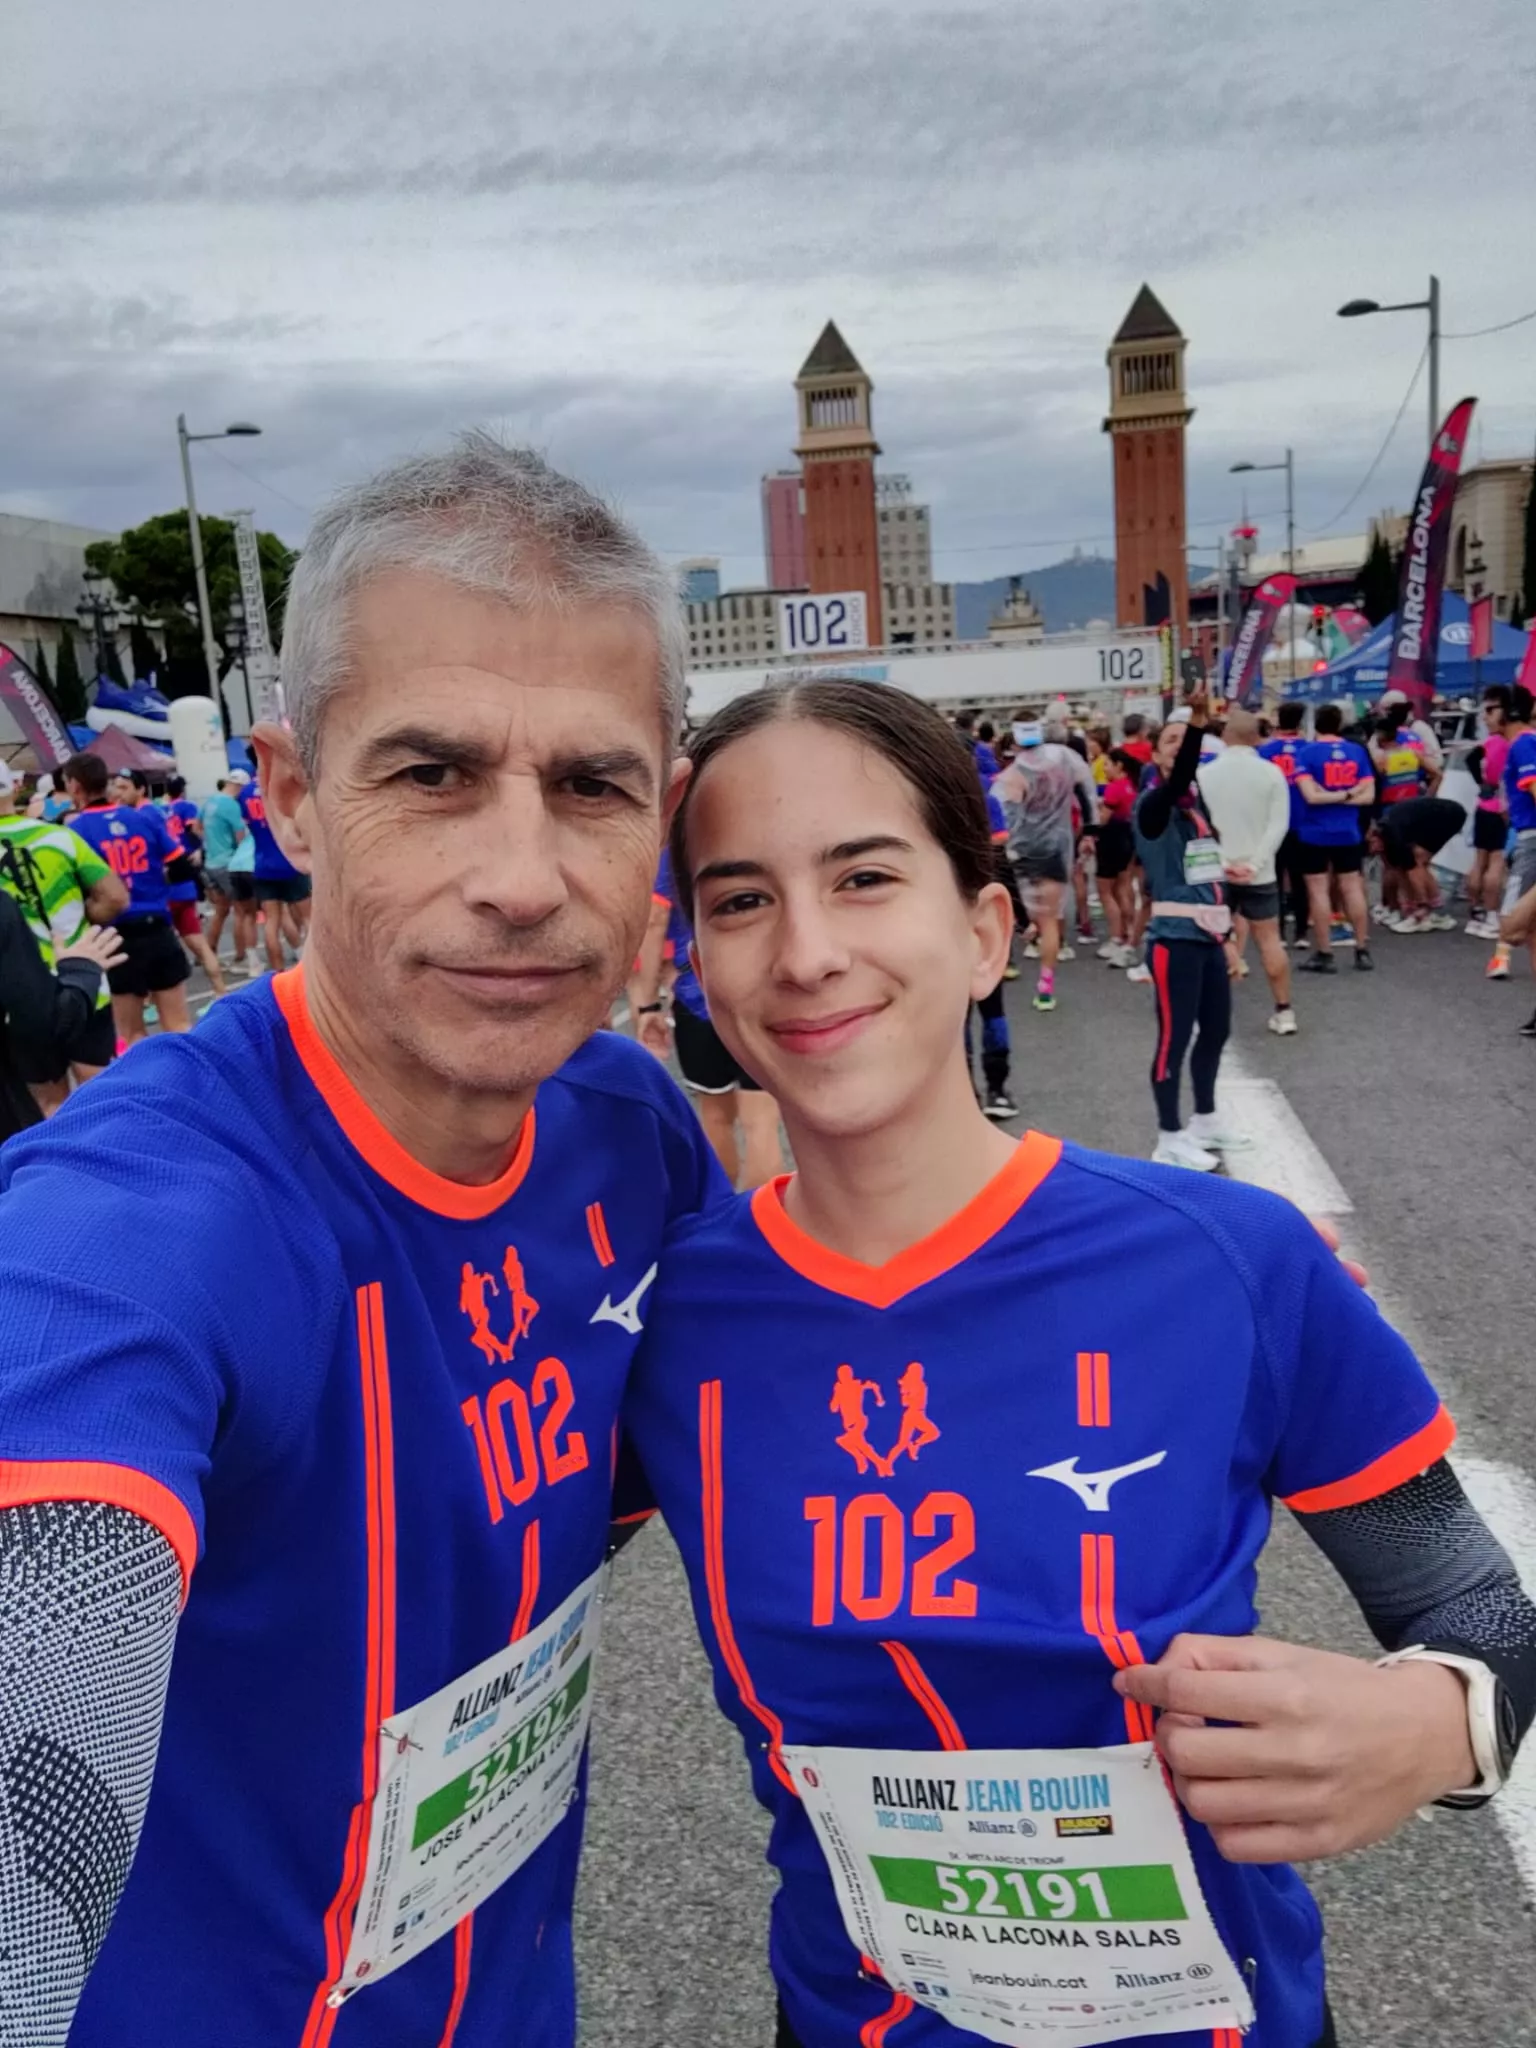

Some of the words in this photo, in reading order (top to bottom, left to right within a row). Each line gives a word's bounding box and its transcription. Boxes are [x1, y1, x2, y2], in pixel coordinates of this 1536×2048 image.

[1399, 486, 1437, 660] BARCELONA
[785, 600, 847, 648] 102
[1097, 647, 1143, 682] 102
[1225, 608, 1263, 699] BARCELONA
[1323, 760, 1358, 787] 102
[100, 835, 149, 875] 102
[461, 1356, 589, 1525] 102
[804, 1491, 978, 1626] 102
[449, 1661, 524, 1733] ALLIANZ
[464, 1689, 569, 1811] 52192
[420, 1822, 465, 1866] JOSE
[470, 1806, 485, 1830] M
[488, 1751, 546, 1813] LACOMA
[871, 1775, 960, 1811] ALLIANZ
[965, 1778, 1023, 1812] JEAN
[1028, 1773, 1111, 1812] BOUIN
[876, 1810, 900, 1829] 102
[967, 1820, 1017, 1835] Allianz
[1059, 1816, 1109, 1829] MUNDO
[936, 1866, 1112, 1919] 52191
[905, 1913, 976, 1943] CLARA
[984, 1923, 1089, 1949] LACOMA
[1099, 1927, 1182, 1949] SALAS
[968, 1968, 1088, 1989] jeanbouin.cat
[1115, 1970, 1184, 1990] Allianz
